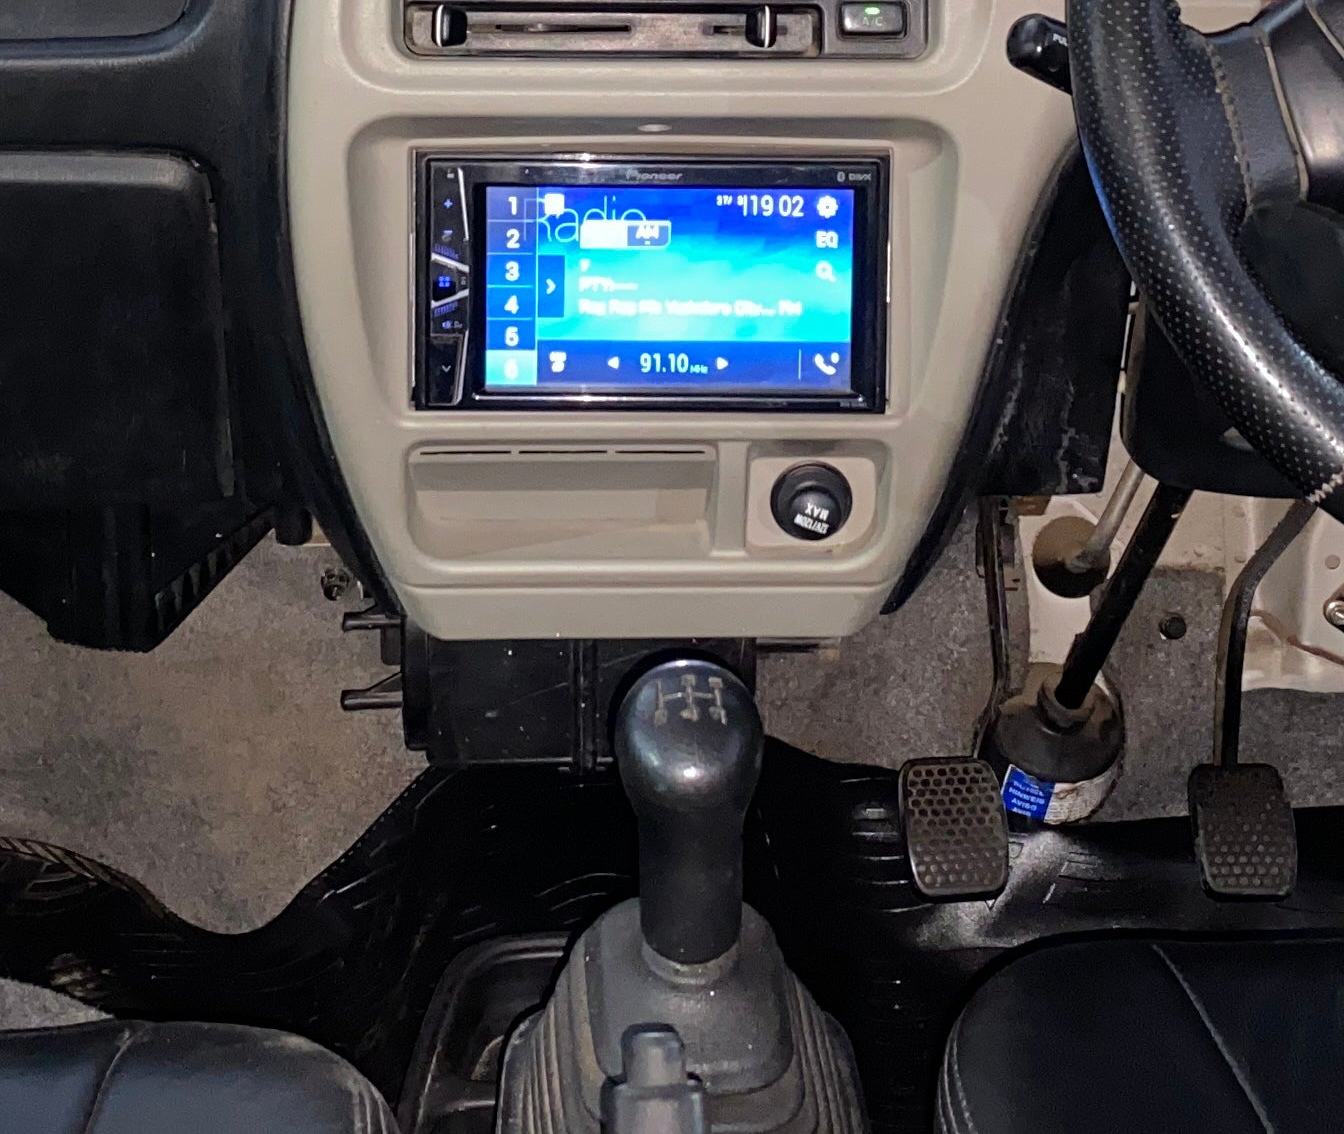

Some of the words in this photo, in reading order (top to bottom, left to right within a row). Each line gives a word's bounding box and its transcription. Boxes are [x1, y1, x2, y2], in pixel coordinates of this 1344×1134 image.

[862, 16, 884, 27] A/C
[508, 196, 518, 216] 1
[506, 228, 521, 249] 2
[815, 229, 839, 249] EQ
[505, 261, 520, 282] 3
[503, 294, 520, 315] 4
[639, 352, 689, 374] 91.10
[804, 501, 830, 521] MAX
